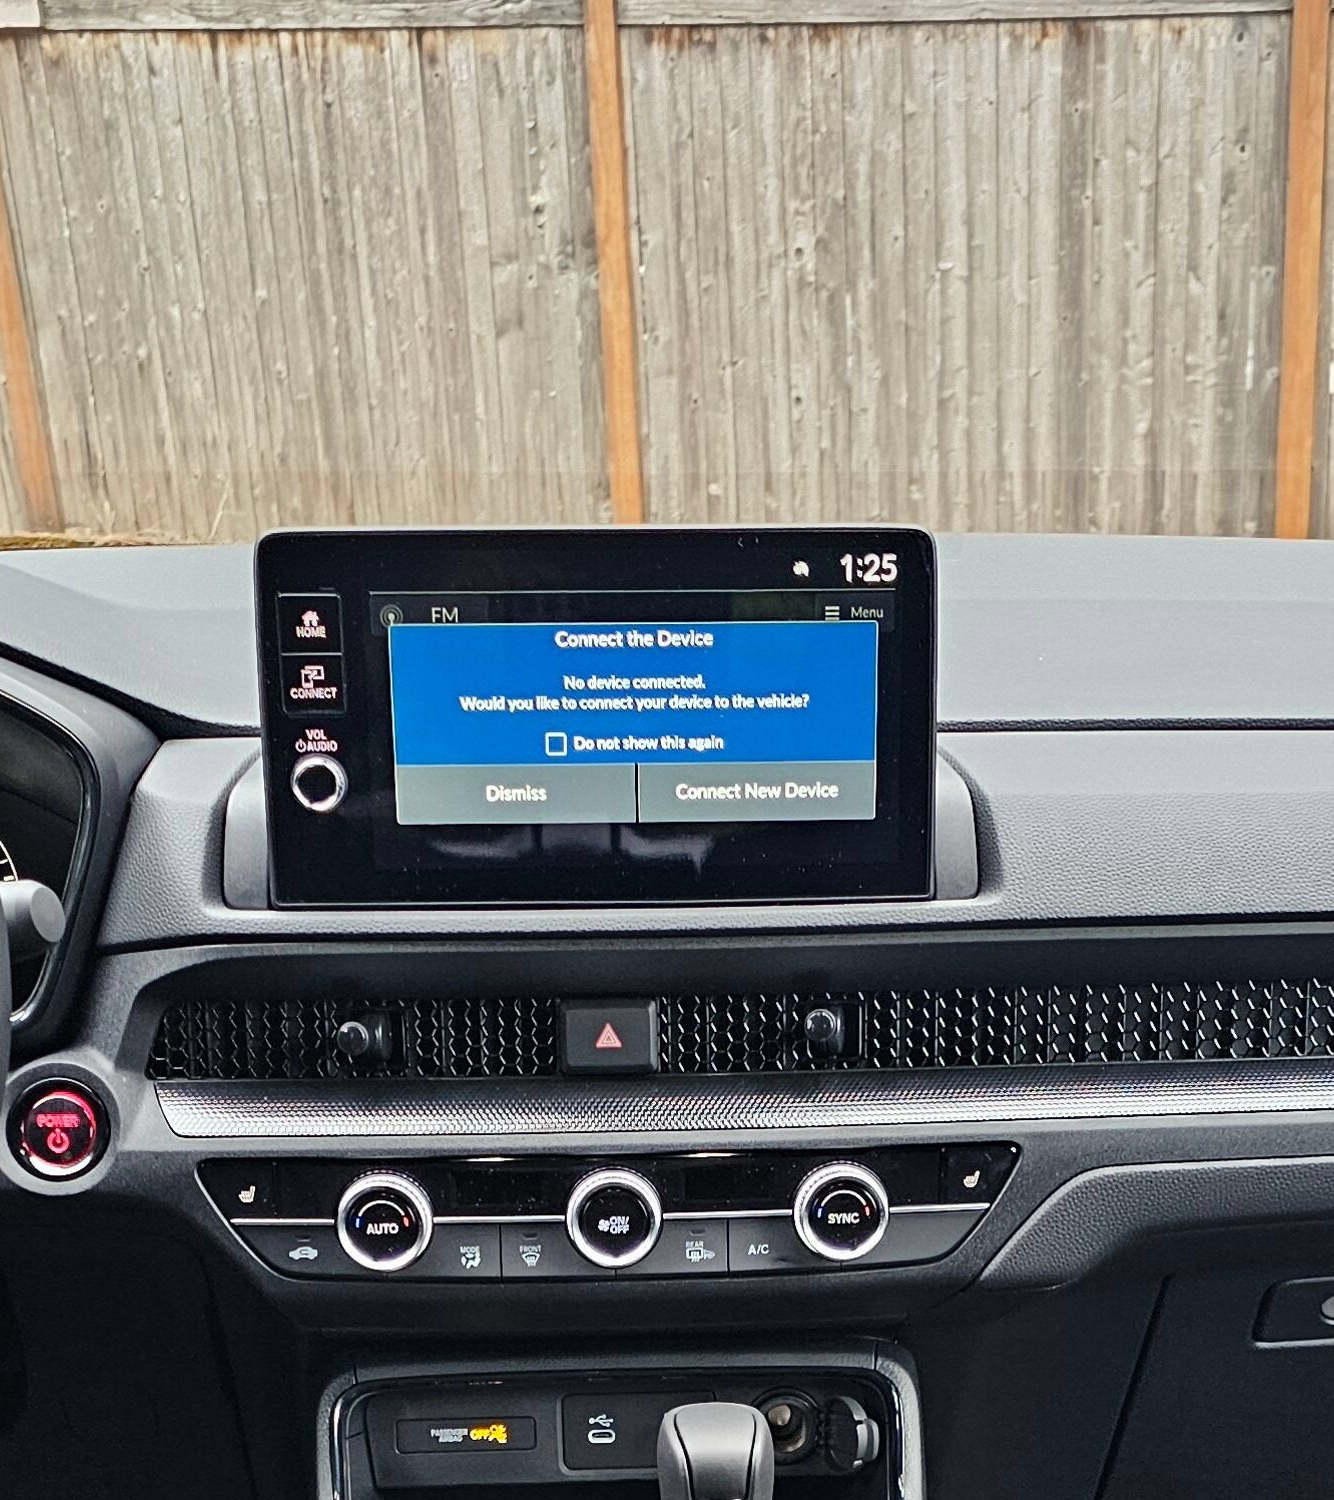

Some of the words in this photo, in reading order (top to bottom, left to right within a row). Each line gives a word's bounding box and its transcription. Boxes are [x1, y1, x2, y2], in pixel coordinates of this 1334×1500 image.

[840, 553, 898, 583] 1:25
[431, 607, 458, 623] FM
[850, 606, 884, 619] Menu
[295, 626, 327, 638] HOME
[554, 631, 624, 648] Connect
[627, 630, 655, 647] the
[657, 630, 714, 647] Device
[563, 675, 585, 690] No
[587, 674, 630, 690] device
[632, 673, 706, 690] connected.
[290, 687, 338, 699] CONNECT
[459, 696, 505, 711] Would
[508, 698, 534, 713] you
[536, 695, 560, 711] like
[562, 696, 577, 710] to
[579, 695, 633, 711] connect
[631, 698, 667, 713] your
[669, 694, 712, 710] device
[714, 695, 730, 709] to
[732, 693, 755, 709] the
[756, 693, 810, 709] vehicle?
[305, 729, 327, 741] VOL
[307, 740, 338, 752] AUDIO
[573, 736, 595, 751] Do
[597, 736, 622, 751] not
[622, 735, 658, 751] show
[660, 735, 686, 750] this
[688, 735, 724, 752] again
[486, 785, 547, 802] Dismiss
[675, 783, 742, 800] Connect
[744, 782, 781, 799] New
[784, 781, 839, 799] Device
[827, 1211, 860, 1225] SYNC
[366, 1222, 399, 1236] AUTO
[459, 1246, 480, 1254] MODE
[519, 1245, 542, 1253] FRONT
[748, 1243, 769, 1255] A/C
